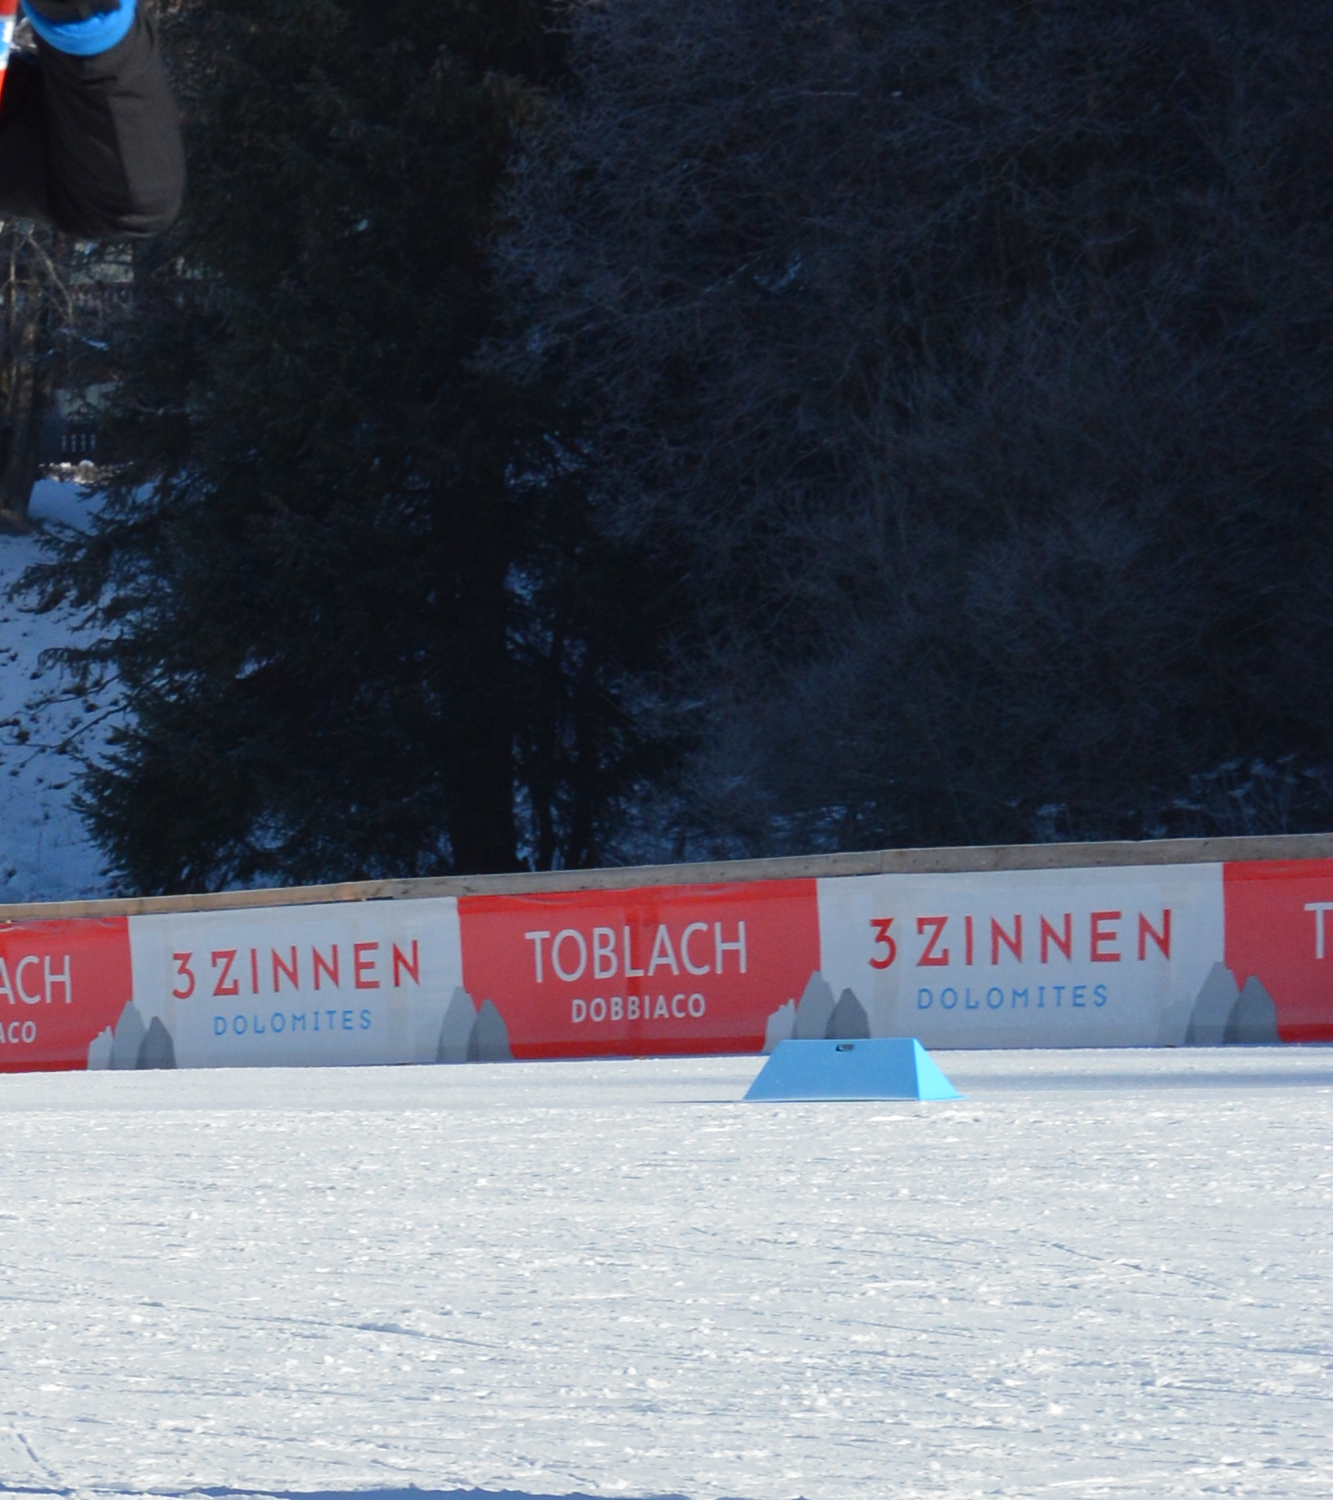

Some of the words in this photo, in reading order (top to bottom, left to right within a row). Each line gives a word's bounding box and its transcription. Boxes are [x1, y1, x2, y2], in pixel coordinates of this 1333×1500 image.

[525, 920, 748, 984] TOBLACH
[571, 993, 707, 1024] DOBBIACO
[916, 983, 1109, 1012] DOLOMITES
[212, 1008, 373, 1037] DOLOMITES
